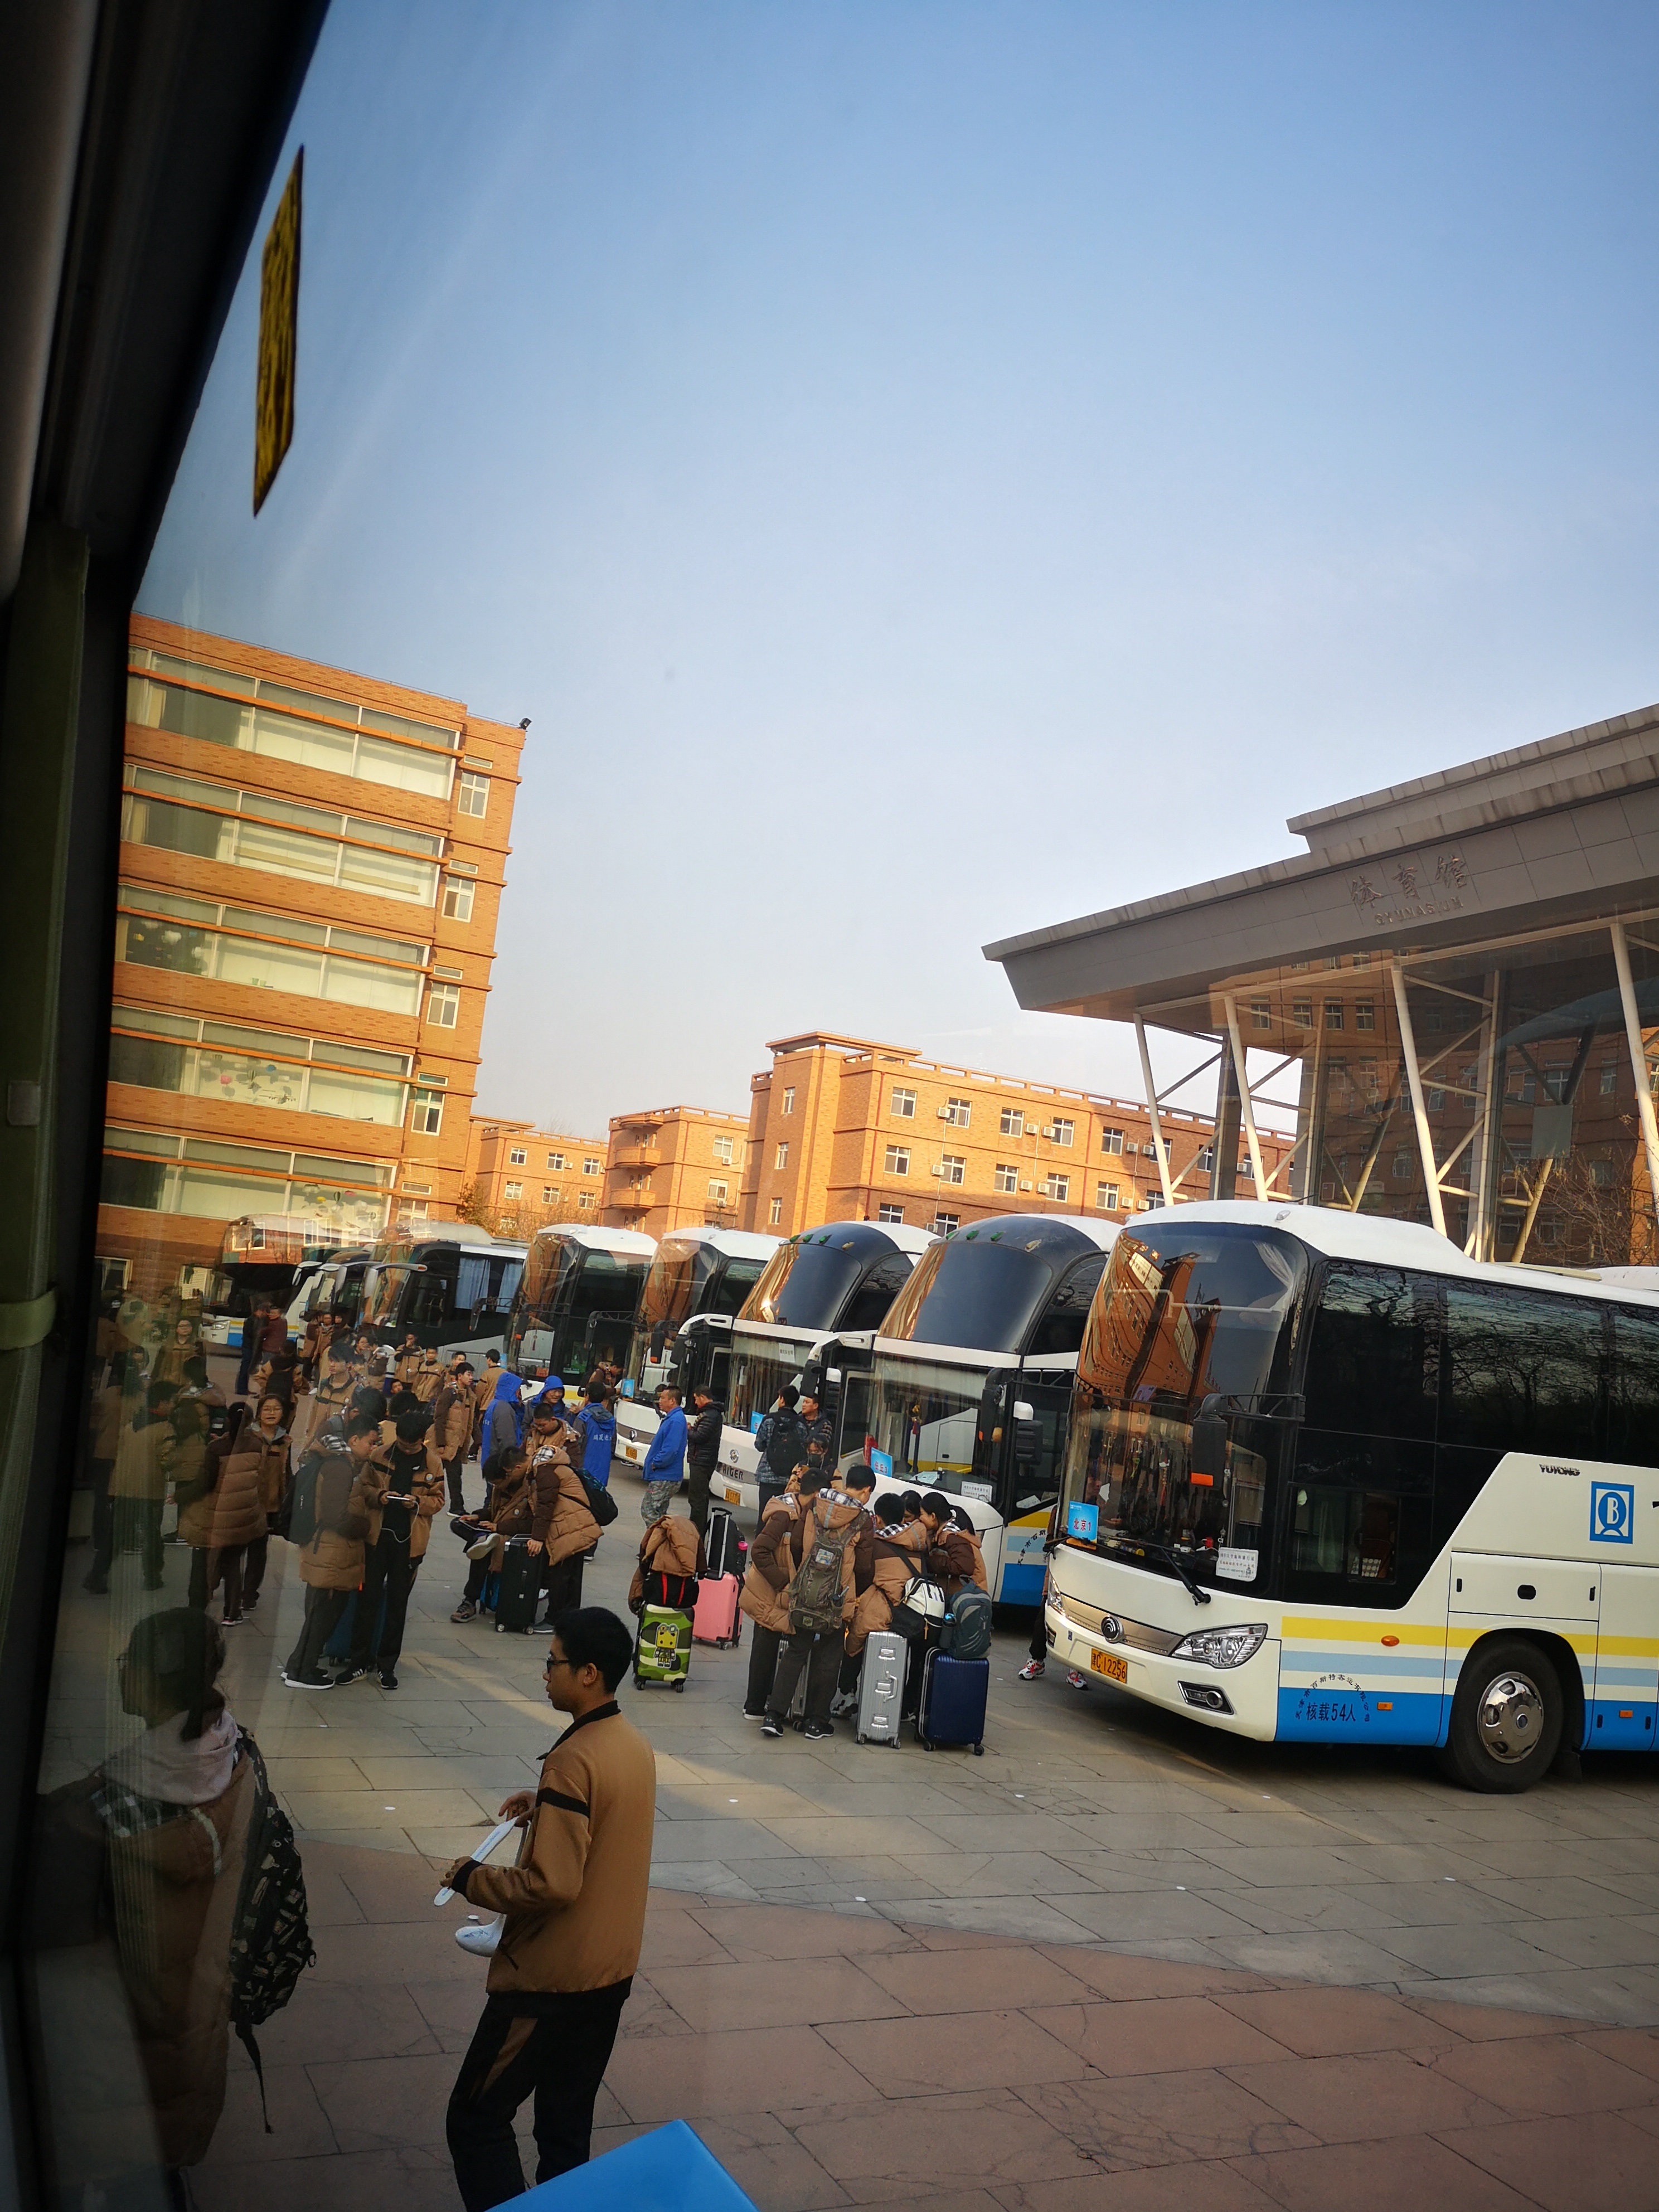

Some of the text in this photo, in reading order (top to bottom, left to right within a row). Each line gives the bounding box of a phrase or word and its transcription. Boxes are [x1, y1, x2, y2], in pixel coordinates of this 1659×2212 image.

[1351, 855, 1468, 911] 体育馆
[1374, 896, 1464, 926] GYMNASIUM
[1539, 1464, 1581, 1477] YUTONG
[1073, 1517, 1092, 1532] 北京1
[1306, 1702, 1356, 1722] 核载54人
